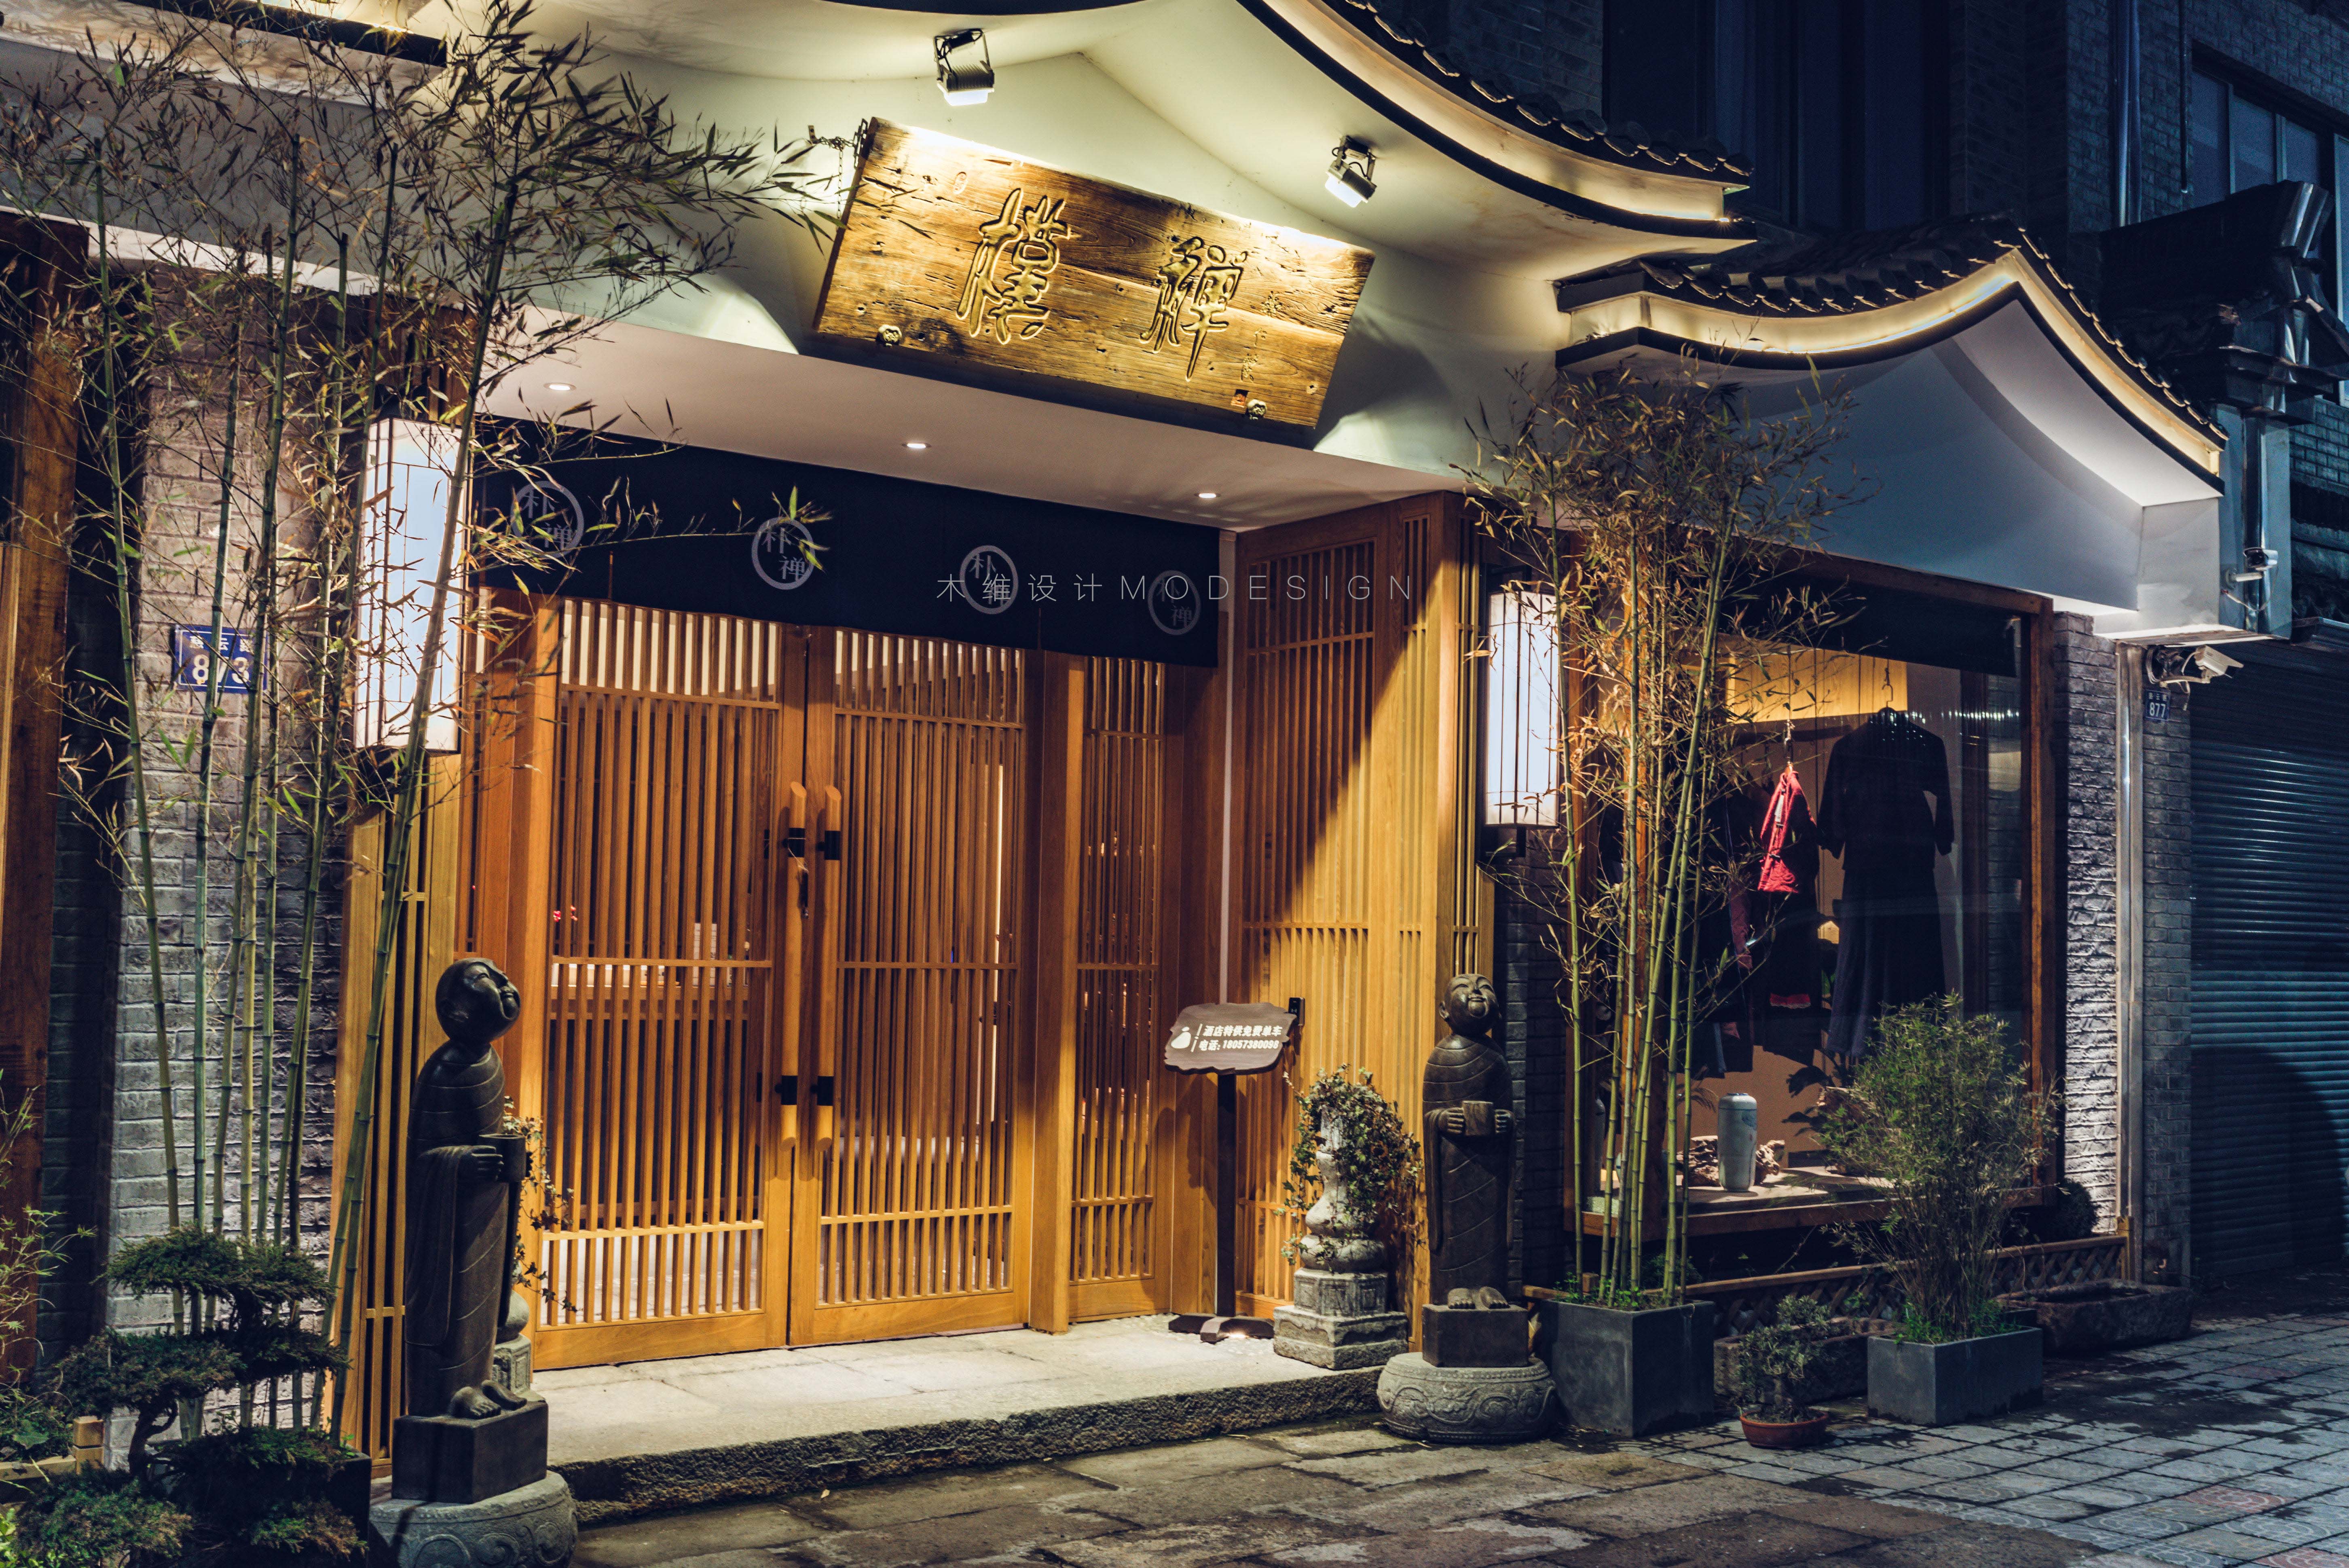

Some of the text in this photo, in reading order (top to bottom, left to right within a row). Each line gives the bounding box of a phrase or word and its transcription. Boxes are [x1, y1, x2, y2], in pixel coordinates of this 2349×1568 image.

[2150, 702, 2166, 718] 877
[1203, 1025, 1283, 1037] 酒店特供免费单车
